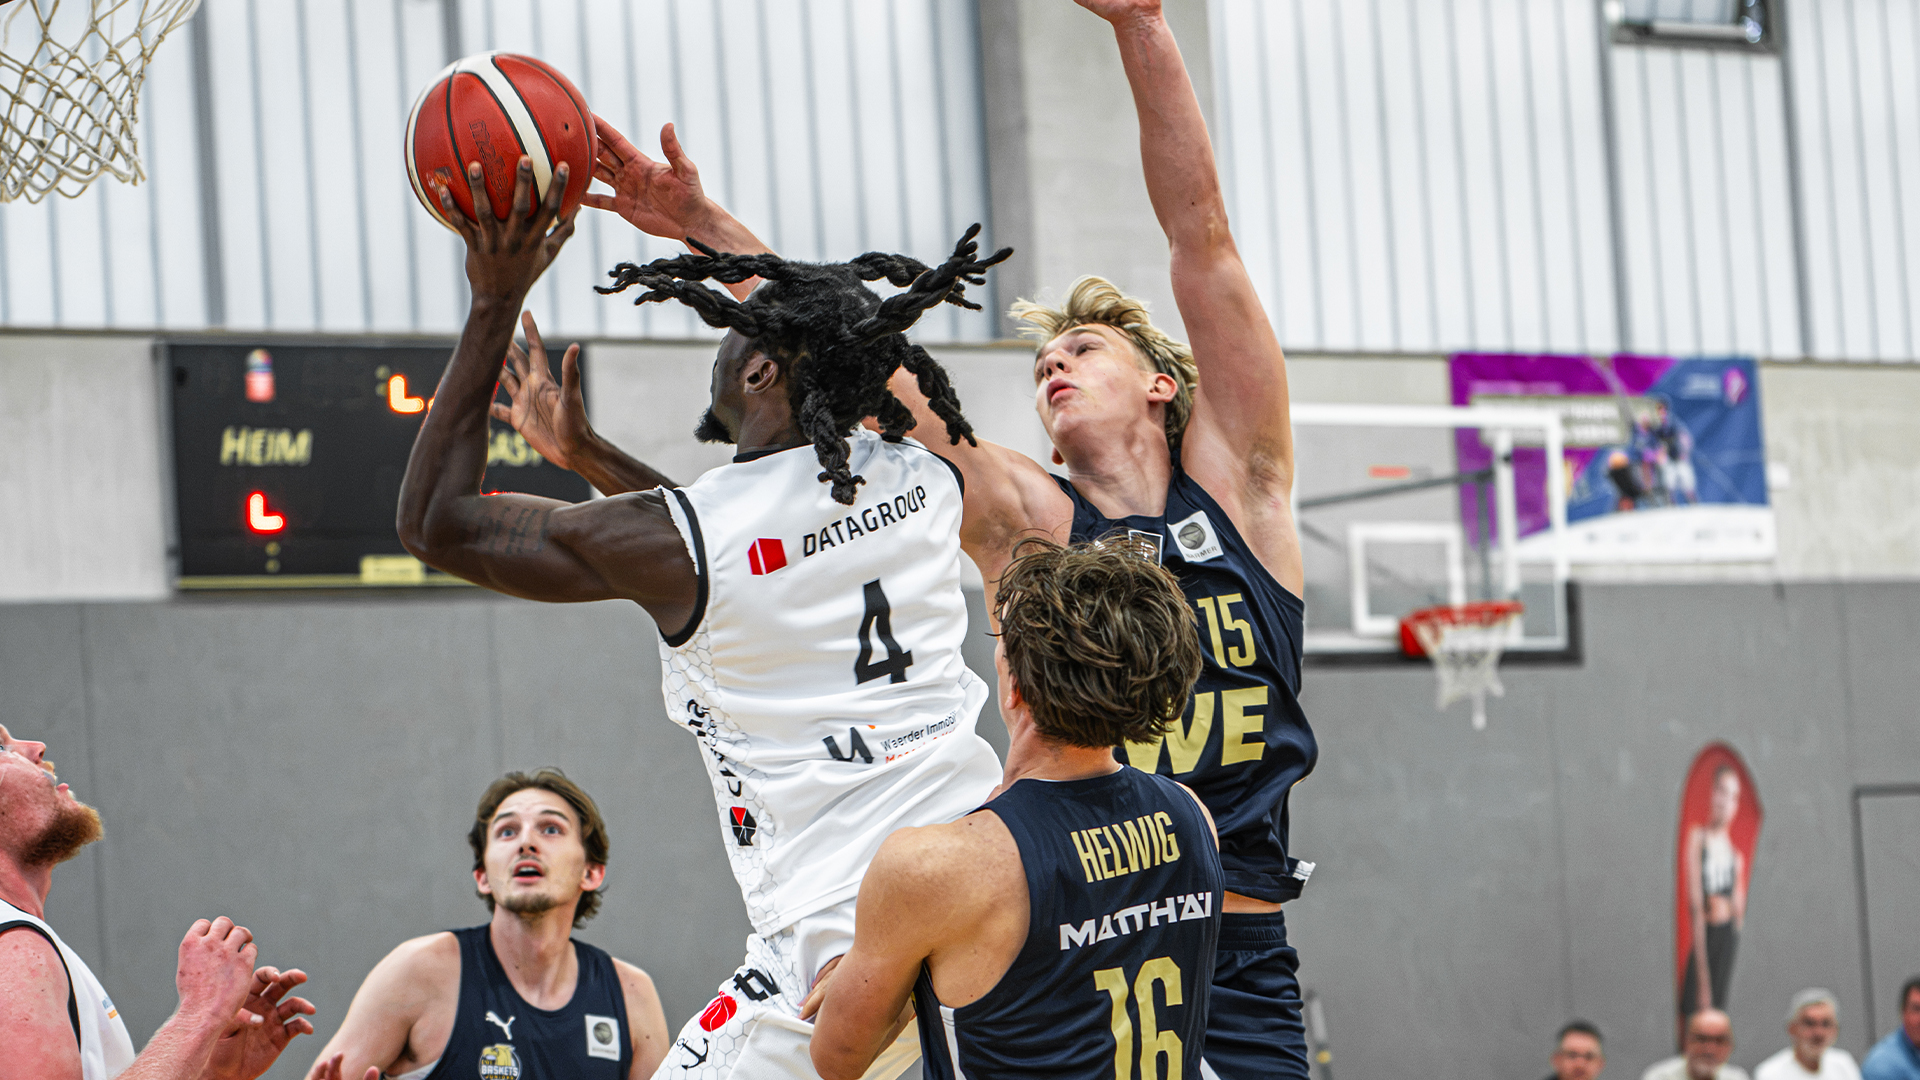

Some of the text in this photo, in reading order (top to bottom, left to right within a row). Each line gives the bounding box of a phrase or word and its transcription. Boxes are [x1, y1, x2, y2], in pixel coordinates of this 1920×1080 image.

[220, 424, 313, 467] HEIM
[802, 484, 927, 558] DATAGROUP
[855, 577, 914, 686] 4
[1196, 592, 1257, 669] 15
[880, 728, 925, 753] Waerder
[1070, 810, 1181, 884] HELWIG
[1059, 891, 1212, 951] MATTHÄI
[1093, 956, 1183, 1080] 16
[481, 1064, 519, 1077] BASKETS
